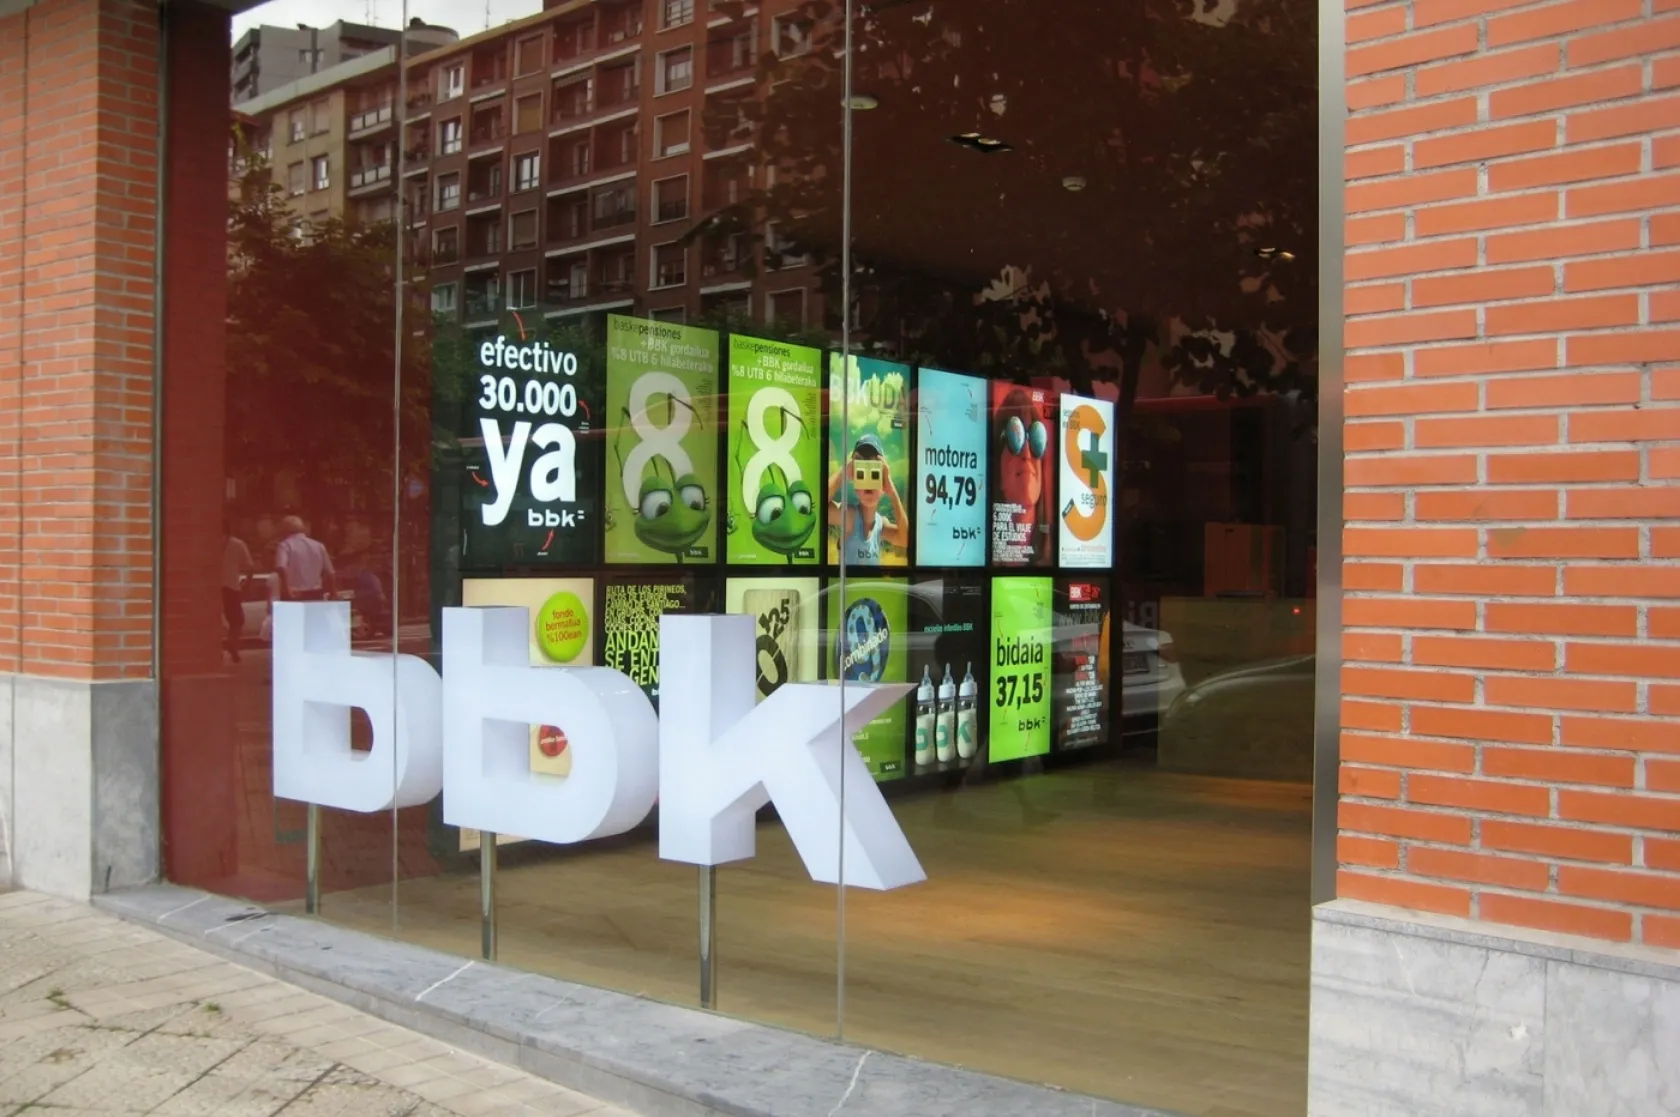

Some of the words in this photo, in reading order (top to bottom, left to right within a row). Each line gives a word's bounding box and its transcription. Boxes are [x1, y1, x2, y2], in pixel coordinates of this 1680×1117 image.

[480, 335, 577, 376] efectivo
[479, 374, 577, 418] 30.000
[479, 417, 577, 526] ya
[925, 444, 978, 469] motorra
[925, 473, 977, 511] 94,79
[605, 630, 659, 652] ANDAN
[630, 647, 659, 668] ENT
[843, 627, 888, 671] ombinado
[996, 636, 1043, 667] bidaia
[630, 665, 659, 686] GEN
[996, 673, 1043, 710] 37,15
[272, 600, 927, 890] bbk
